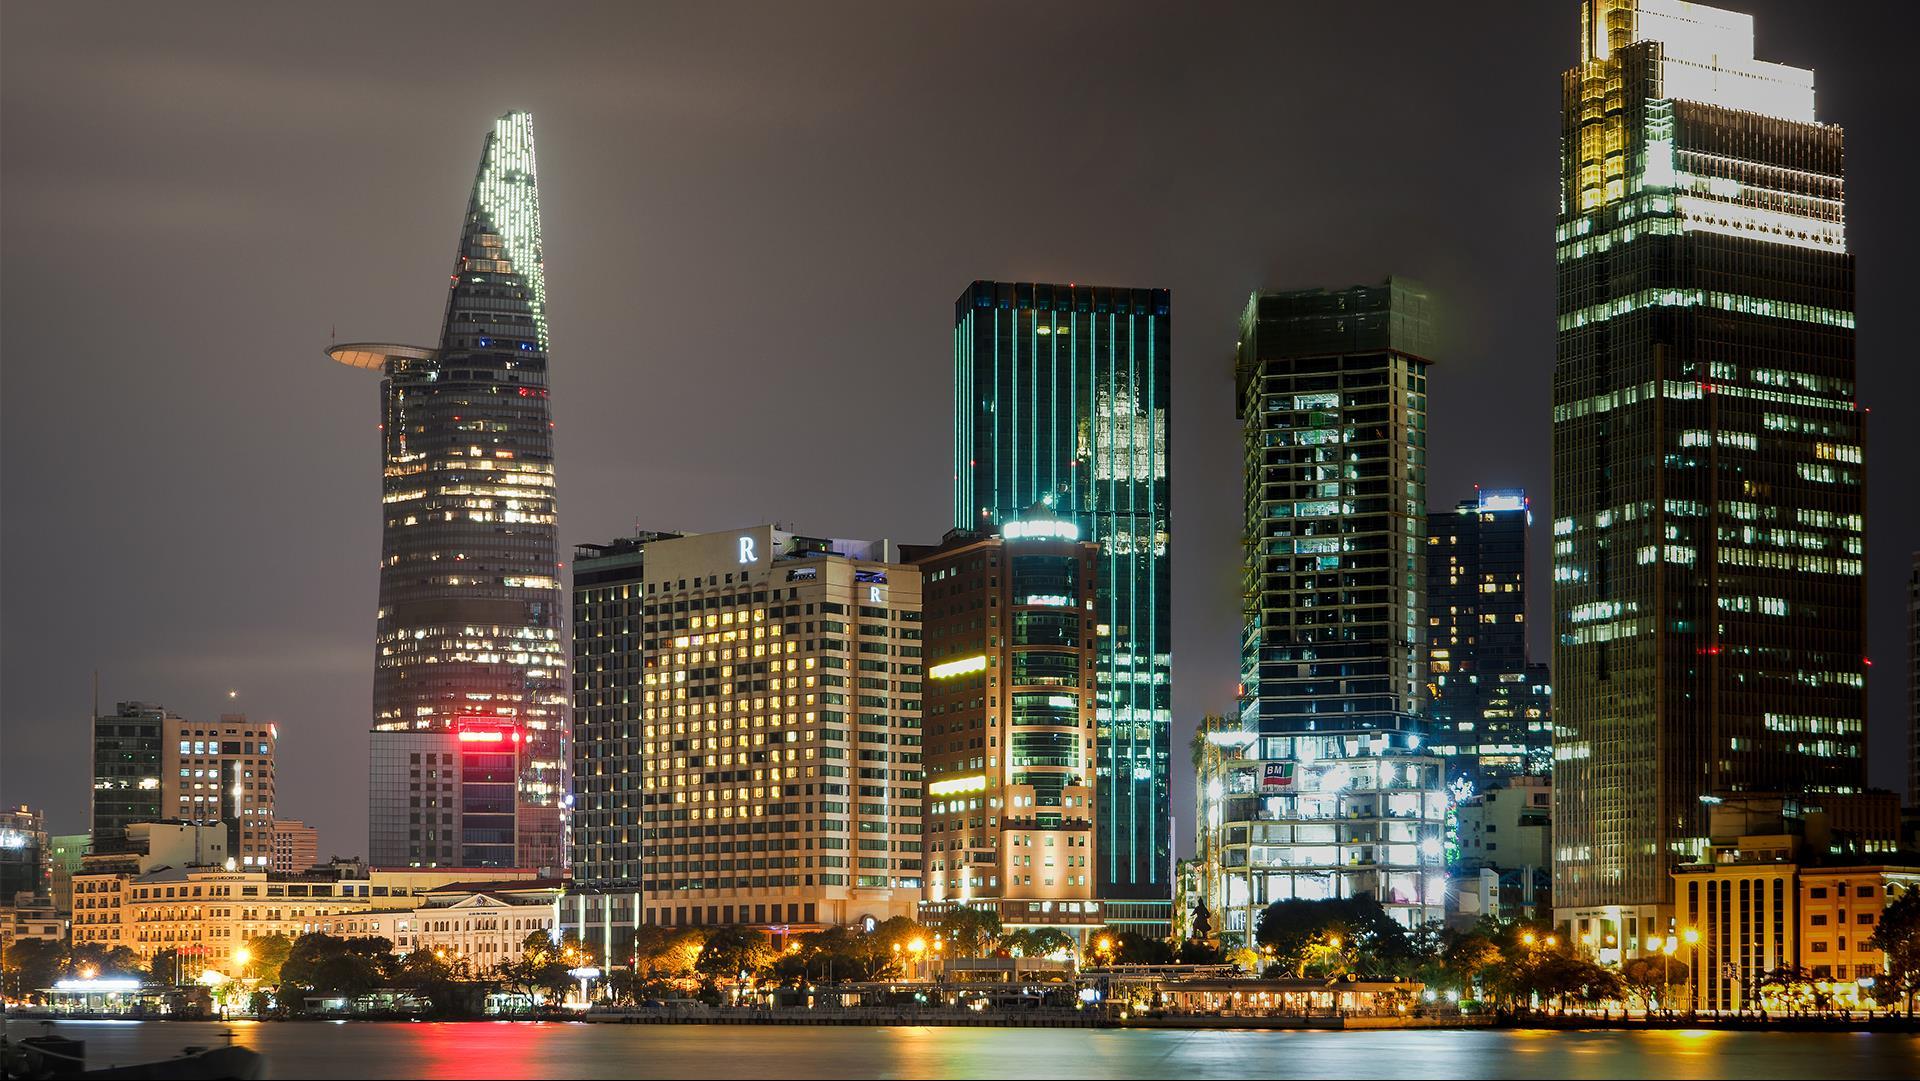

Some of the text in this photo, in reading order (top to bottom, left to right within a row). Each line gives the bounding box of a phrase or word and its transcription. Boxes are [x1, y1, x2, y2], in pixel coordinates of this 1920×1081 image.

[739, 536, 758, 564] R
[870, 586, 881, 602] R
[1267, 766, 1282, 775] BM
[866, 917, 875, 931] R
